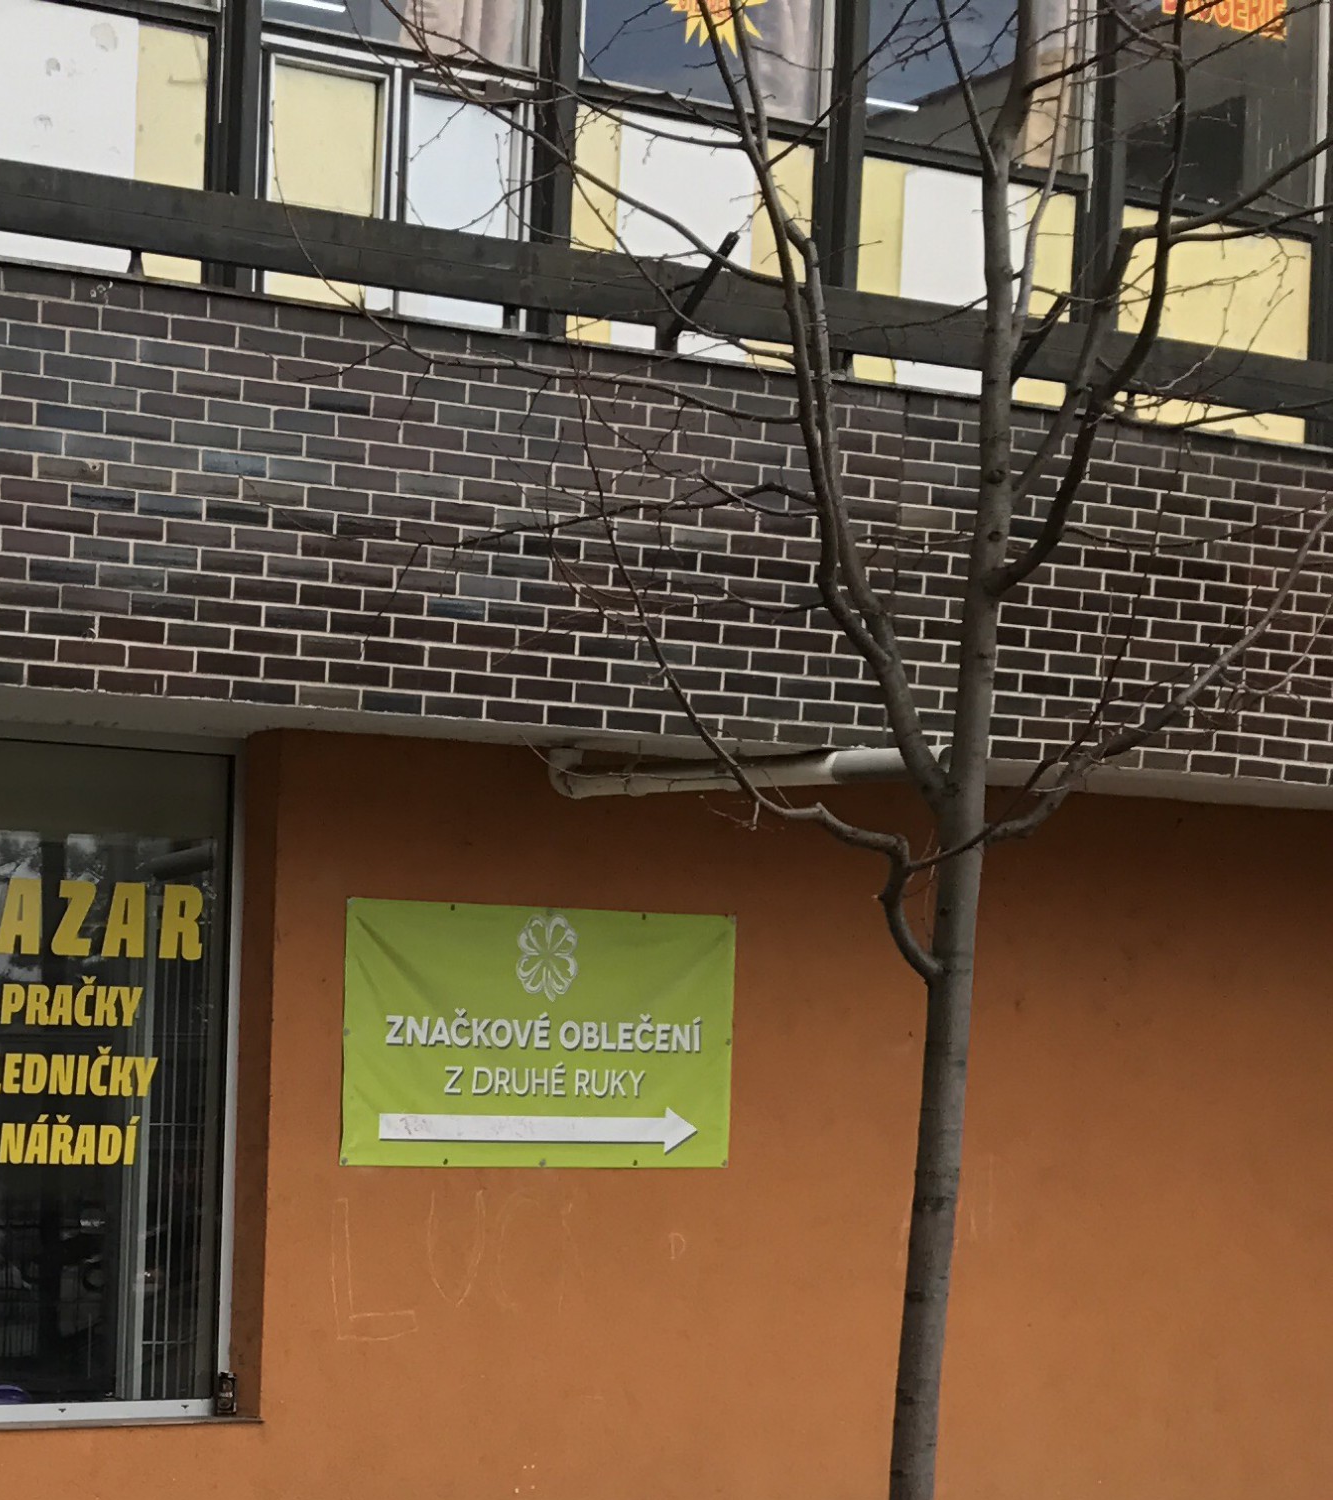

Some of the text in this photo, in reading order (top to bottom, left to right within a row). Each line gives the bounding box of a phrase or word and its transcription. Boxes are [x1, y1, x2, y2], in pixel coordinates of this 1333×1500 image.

[0, 976, 143, 1027] PRAČKY
[385, 1008, 702, 1053] ZNAČKOVÉ OBLEČENÍ
[443, 1062, 647, 1098] Z DRUHÉ RUKY
